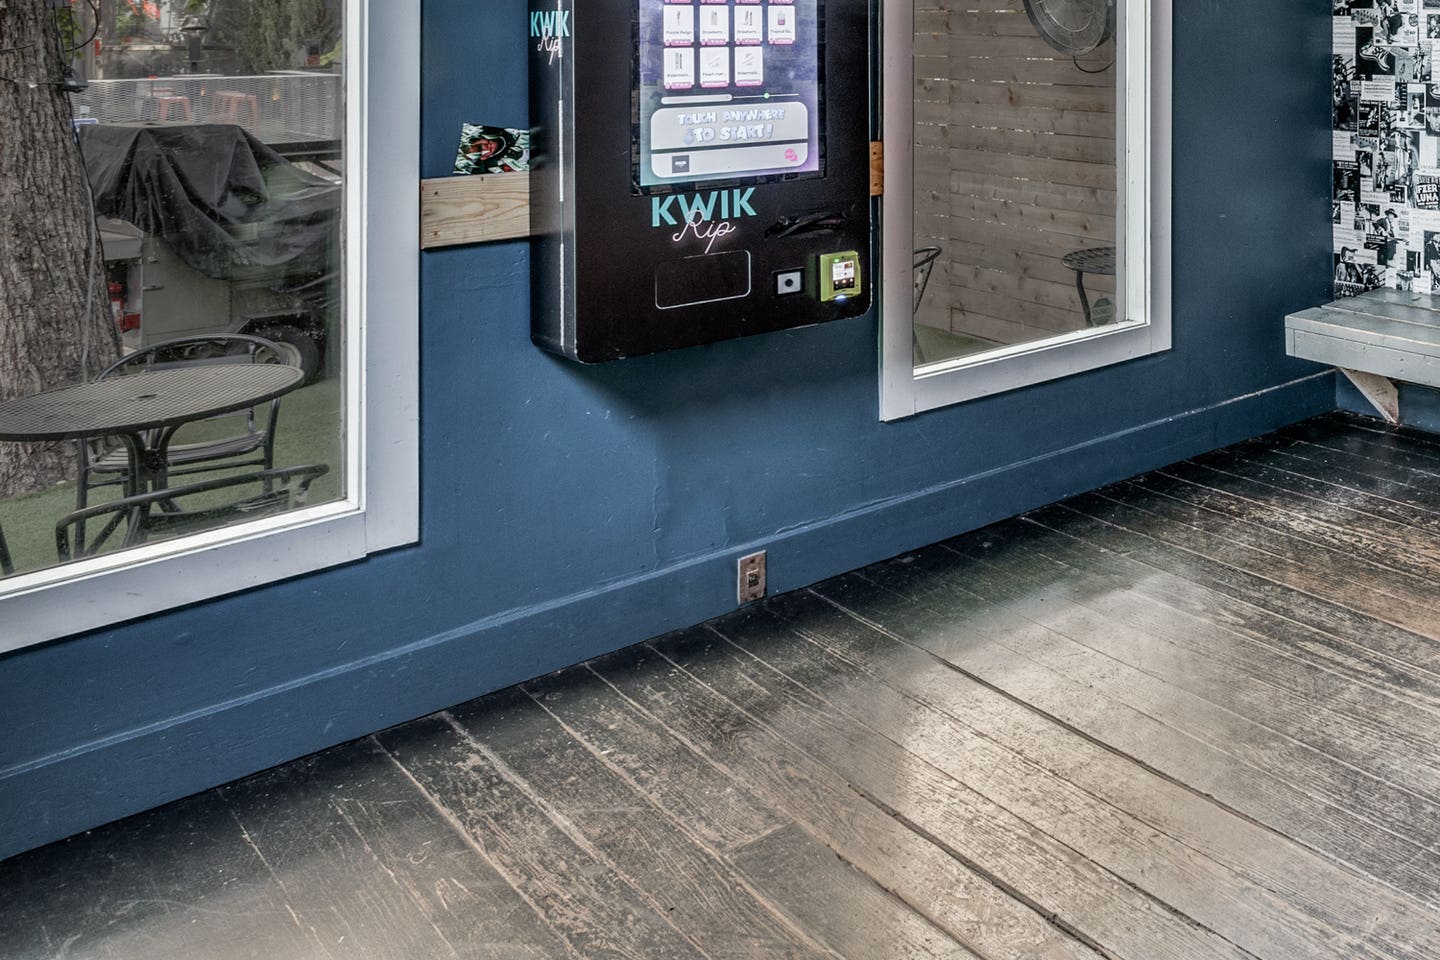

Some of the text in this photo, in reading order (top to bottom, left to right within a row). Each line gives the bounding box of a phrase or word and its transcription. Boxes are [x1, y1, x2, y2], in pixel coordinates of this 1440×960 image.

[677, 108, 785, 126] TOUCH ANYWHERE
[693, 126, 715, 142] TO
[1417, 192, 1439, 202] LUNA
[651, 186, 758, 228] KWIK
[672, 208, 737, 255] Rip
